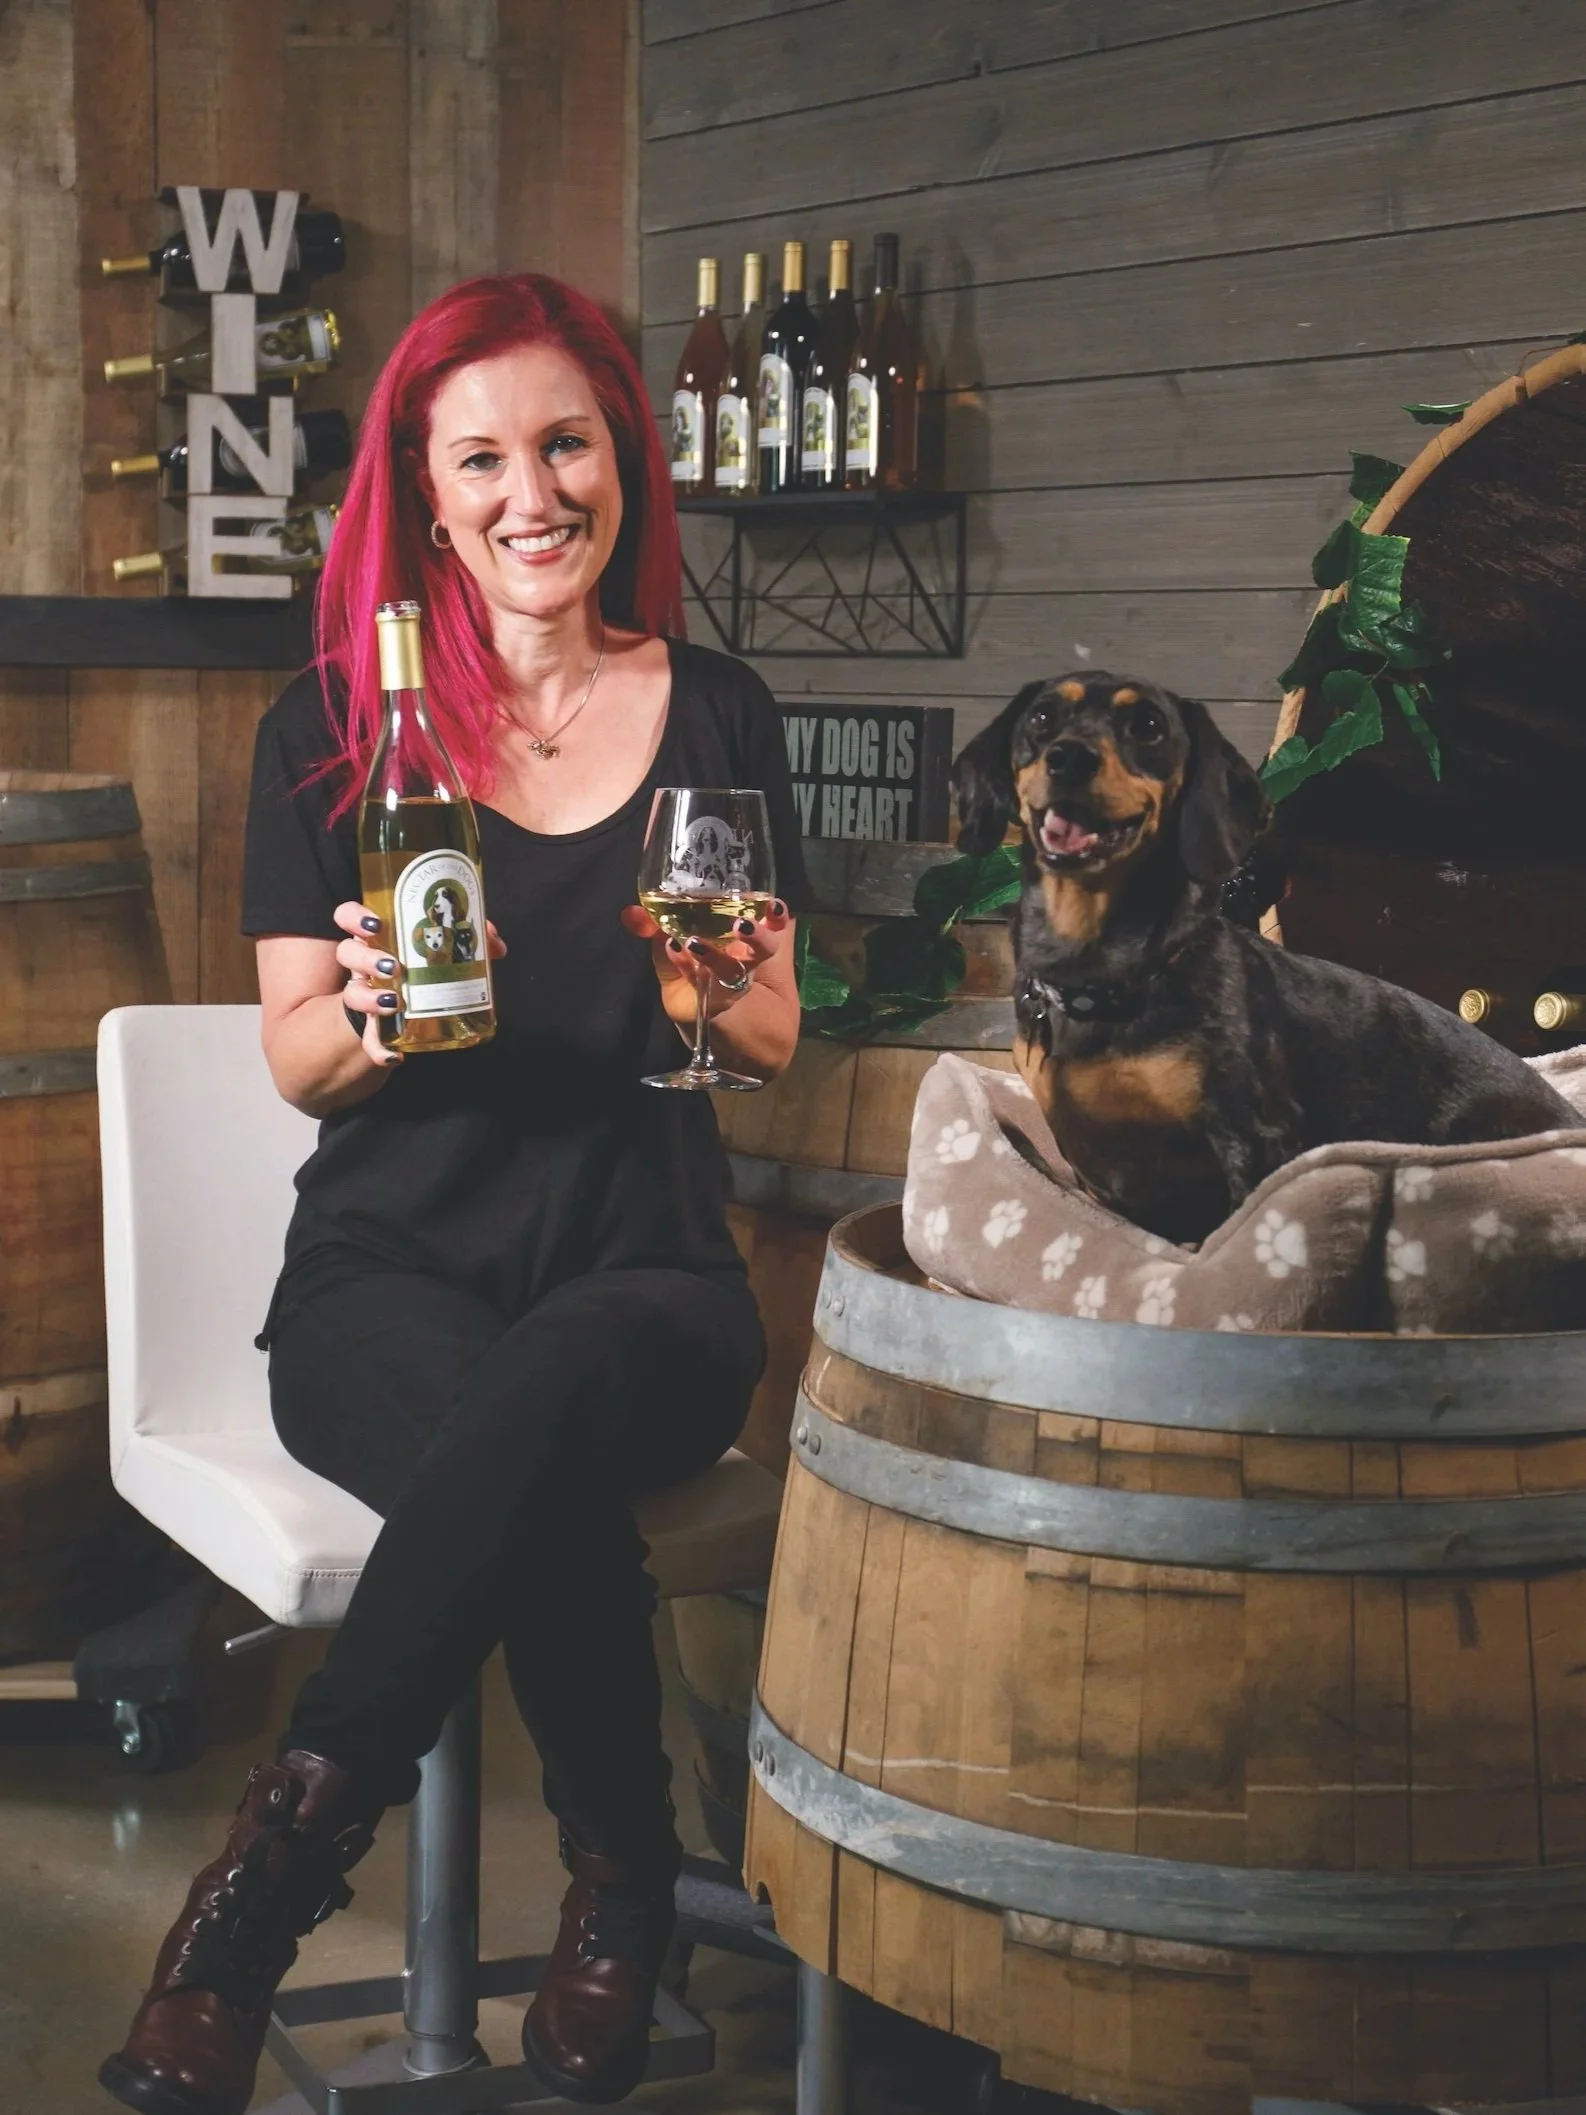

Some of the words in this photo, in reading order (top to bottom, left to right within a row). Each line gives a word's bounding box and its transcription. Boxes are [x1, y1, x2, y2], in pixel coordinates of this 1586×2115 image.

[176, 185, 300, 599] WINE
[821, 717, 880, 778] DOG
[885, 719, 916, 780] IS
[820, 783, 913, 843] HEART
